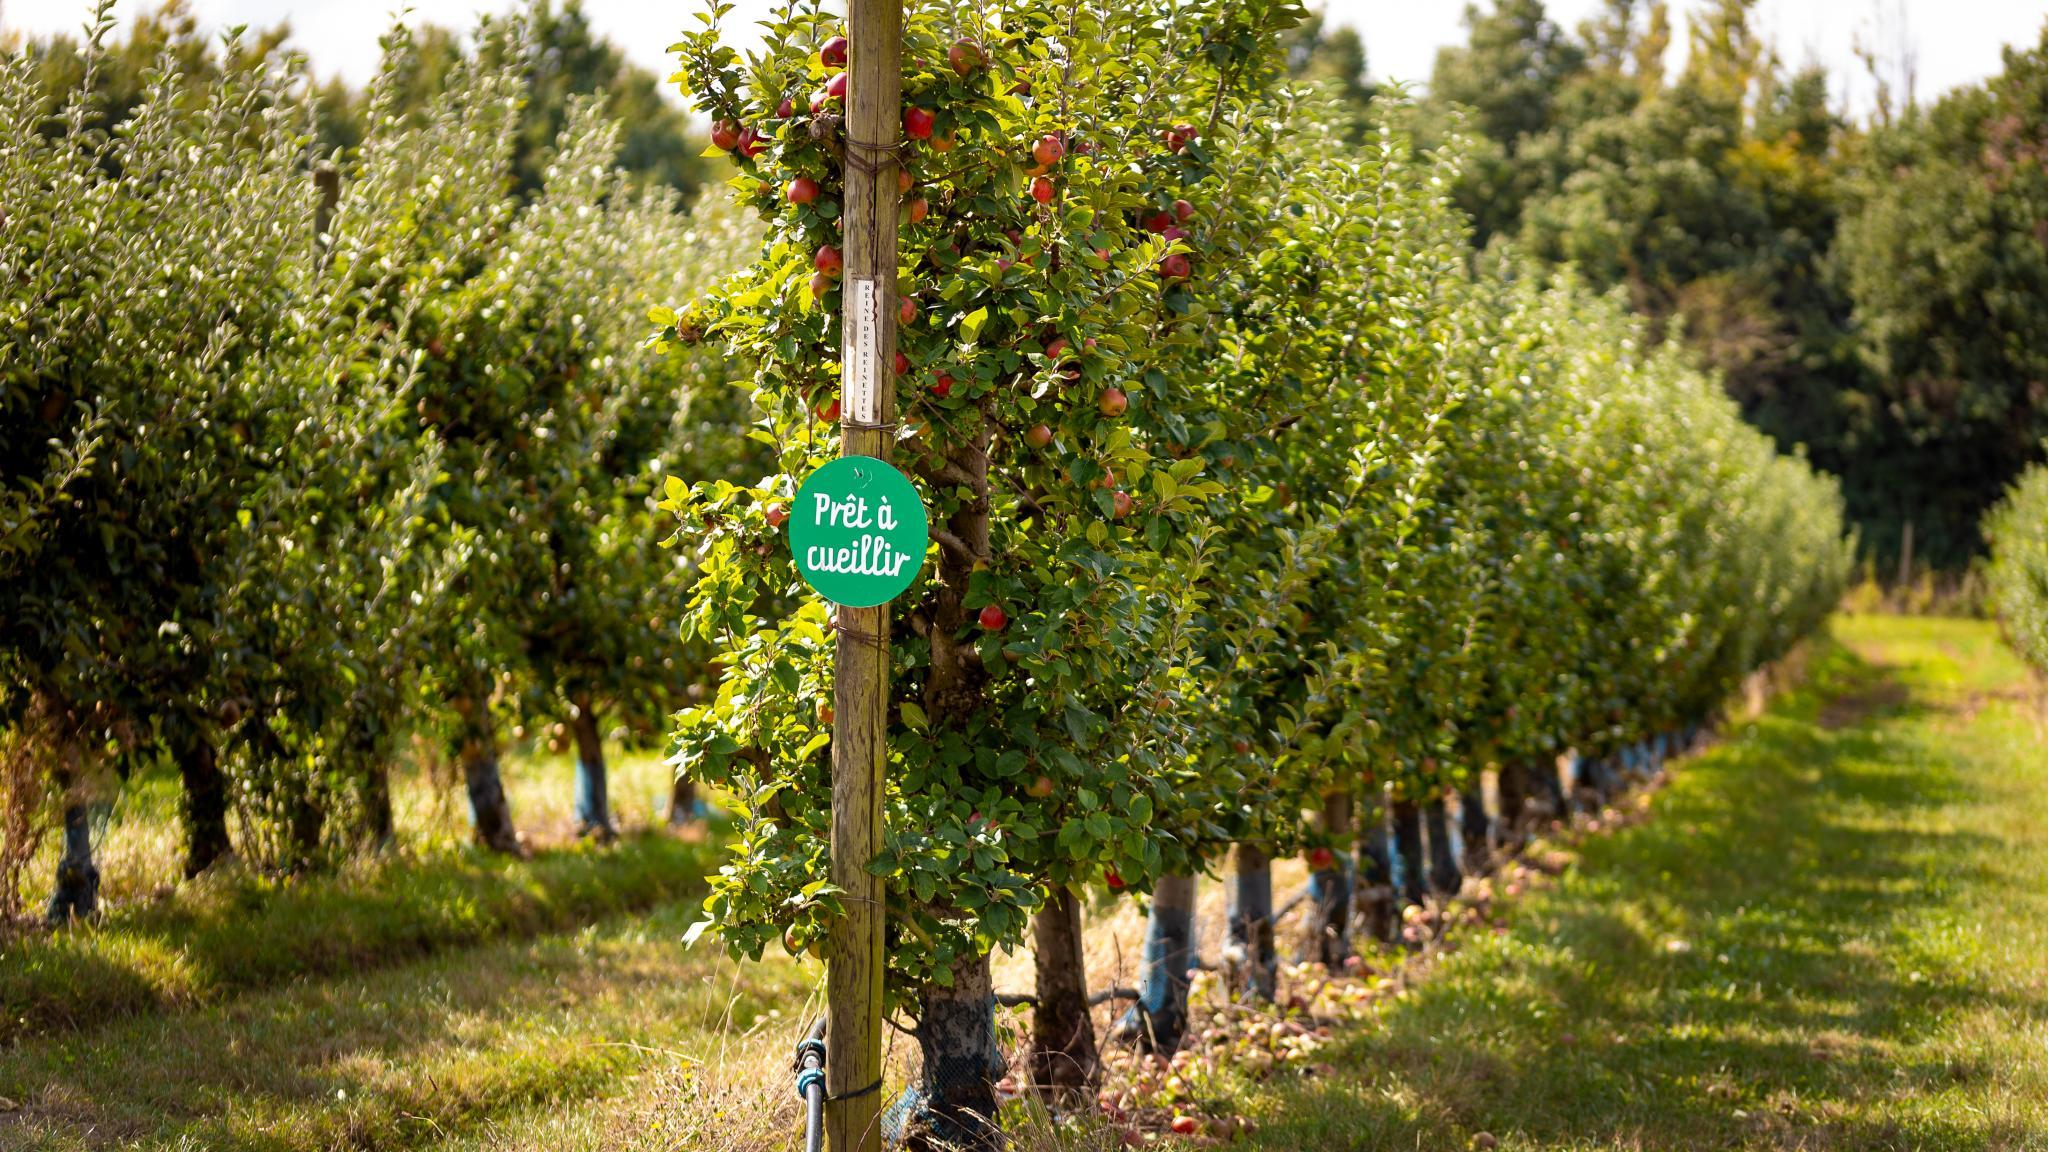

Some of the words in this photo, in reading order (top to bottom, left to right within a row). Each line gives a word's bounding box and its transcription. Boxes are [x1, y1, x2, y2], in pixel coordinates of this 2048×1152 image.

[813, 492, 873, 529] Prêt
[877, 495, 898, 531] à
[806, 533, 911, 577] cueillir
